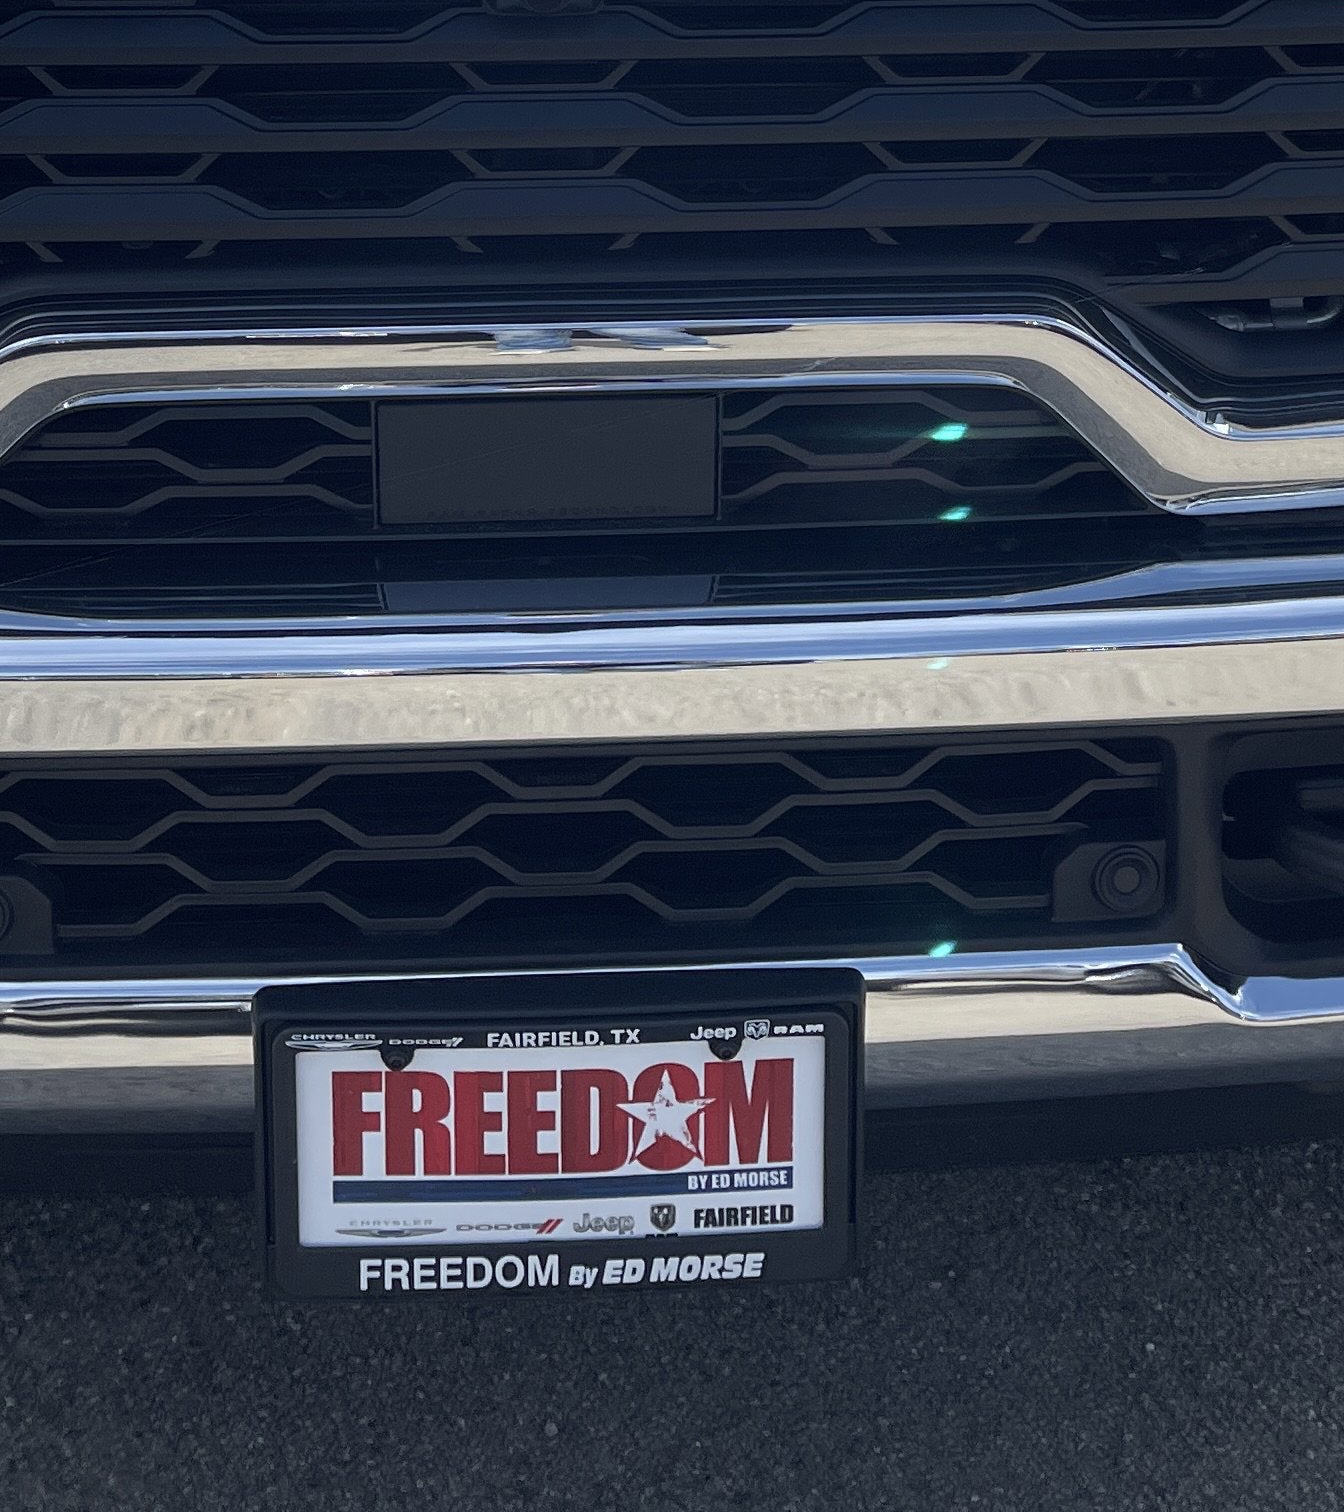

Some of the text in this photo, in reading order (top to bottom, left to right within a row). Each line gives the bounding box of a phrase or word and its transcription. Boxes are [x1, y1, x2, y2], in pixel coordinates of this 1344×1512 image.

[290, 1033, 377, 1041] CHRYSLER
[689, 1026, 737, 1041] Jeep
[773, 1023, 824, 1035] RAM
[388, 1038, 450, 1046] DODGE
[486, 1028, 641, 1049] FAIRFIELD, TX
[332, 1058, 794, 1176] FREEDOM
[687, 1170, 789, 1191] BY ED MORSE
[349, 1218, 433, 1228] CHRYSLER
[573, 1212, 635, 1235] Jeep
[693, 1204, 794, 1229] FAIRFIELD
[456, 1222, 542, 1232] DODGE
[359, 1252, 765, 1291] FREEDOM By ED MORSE
